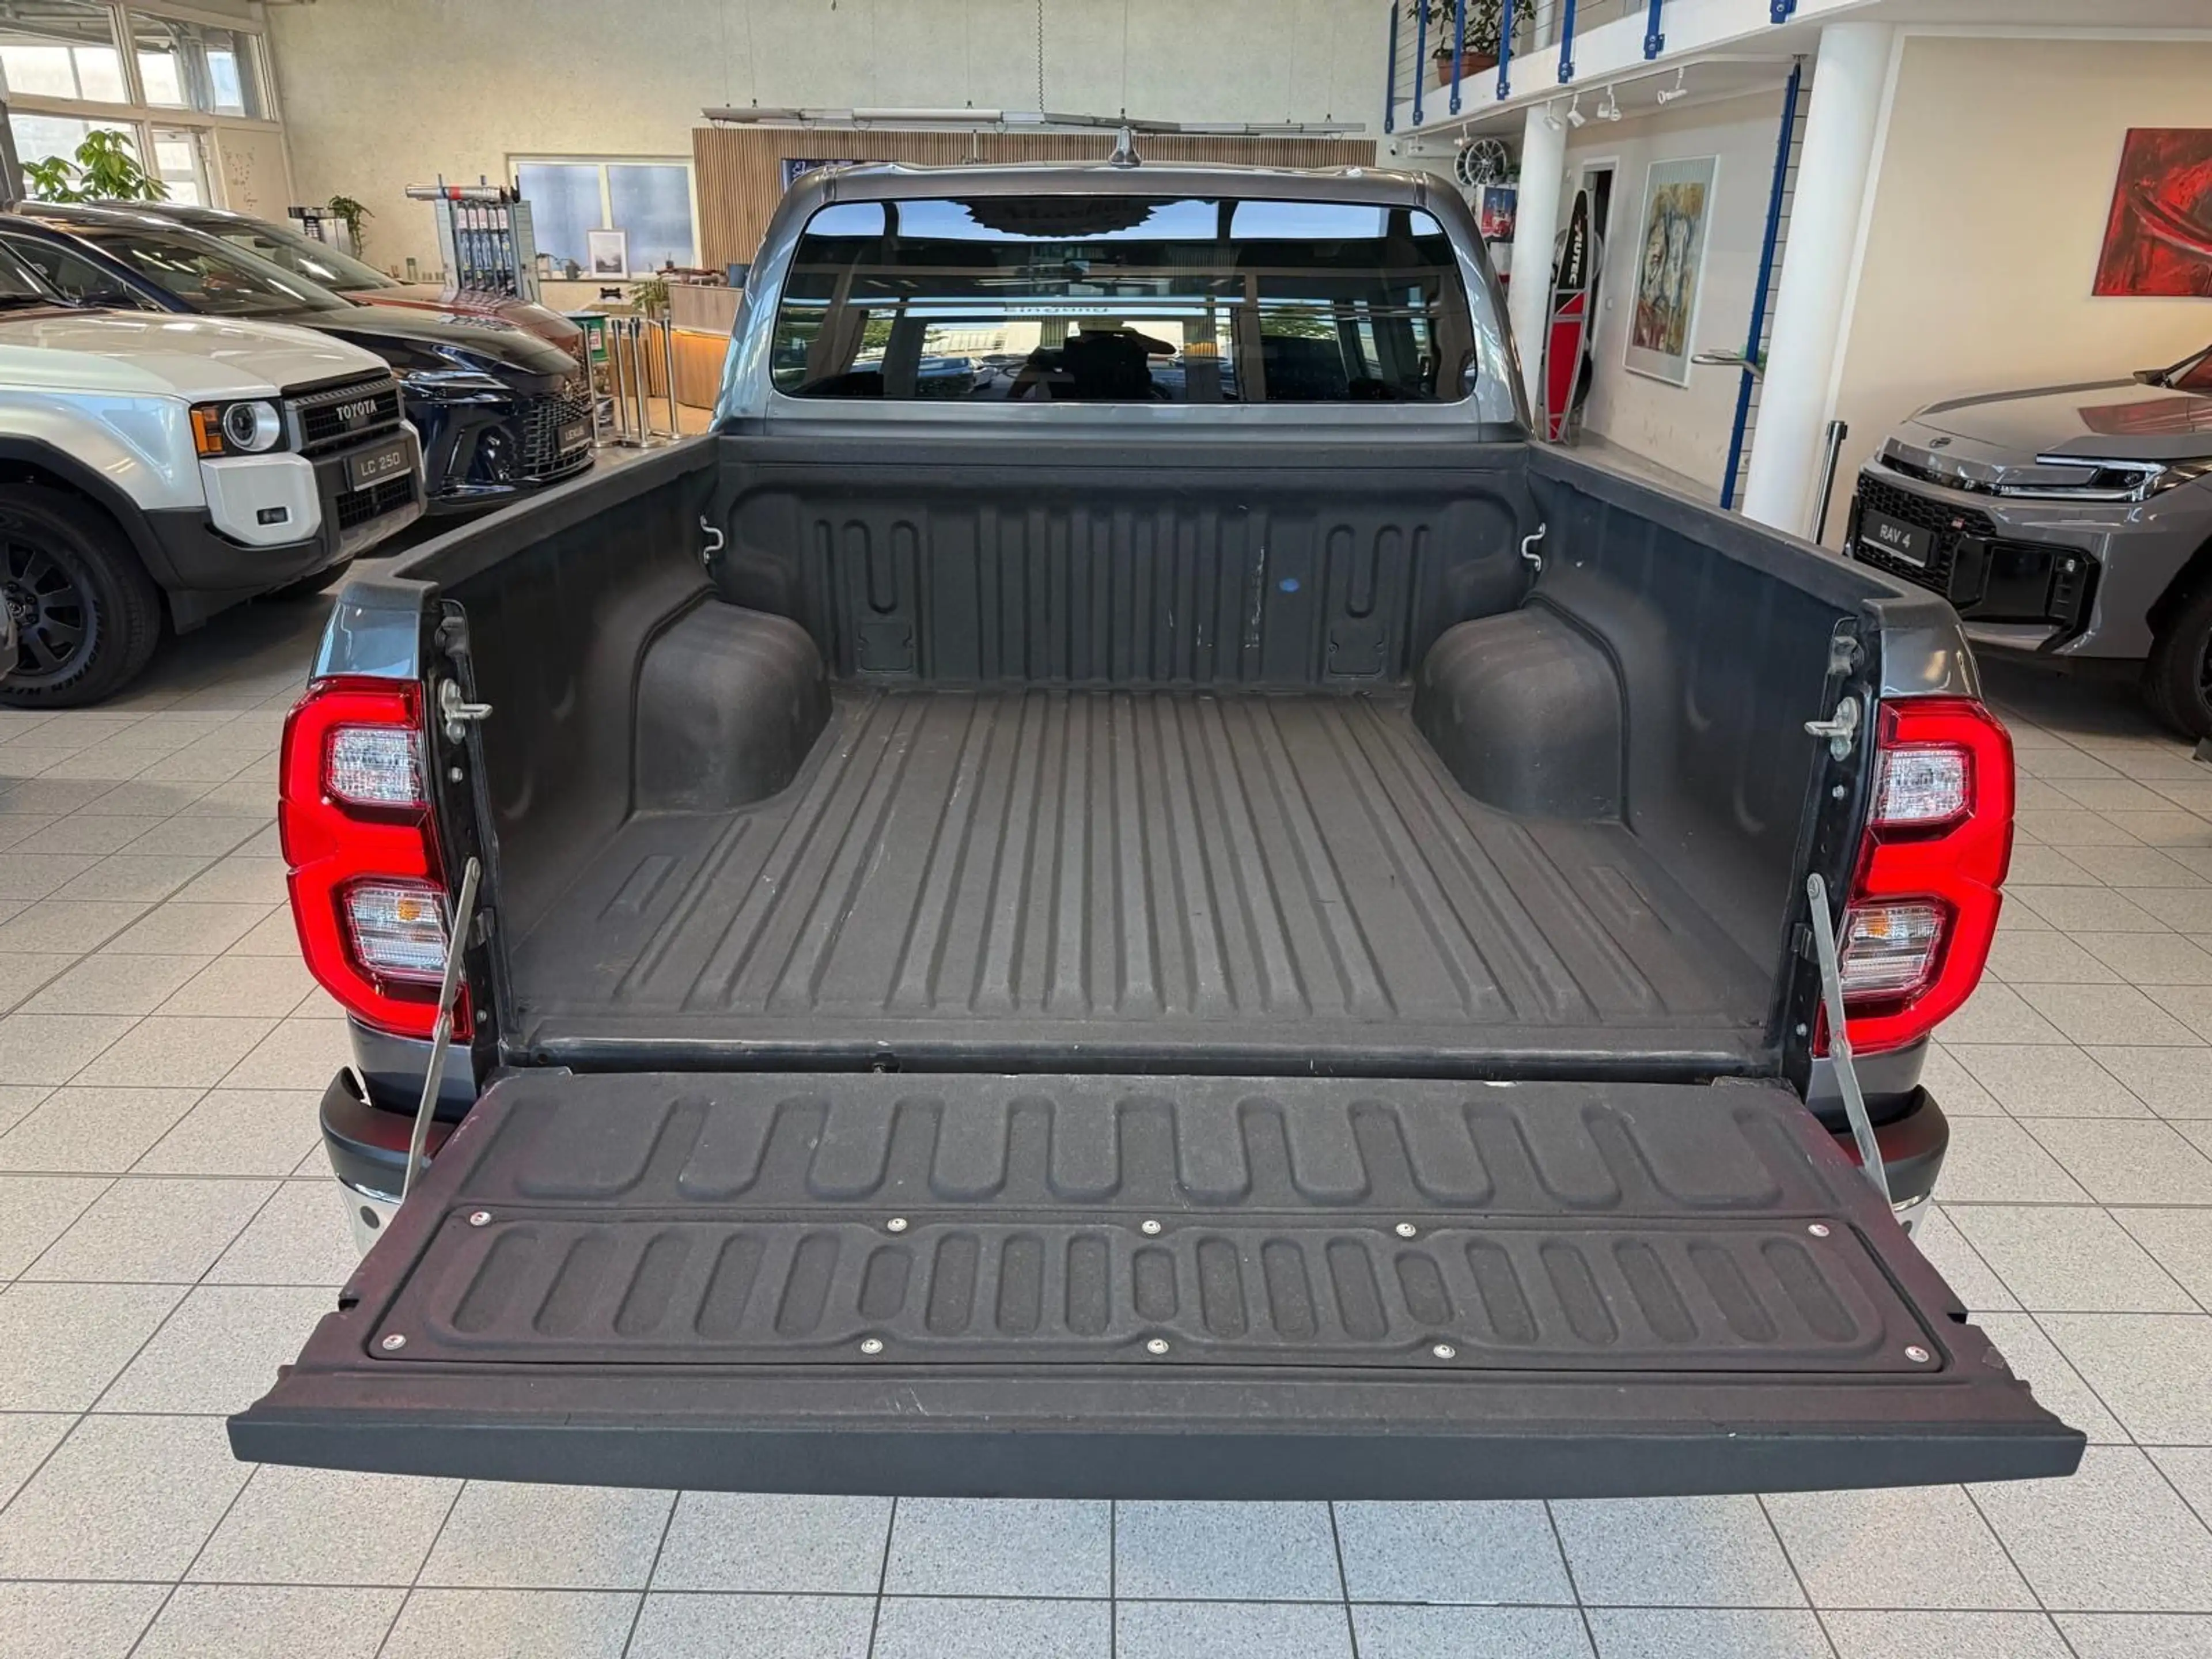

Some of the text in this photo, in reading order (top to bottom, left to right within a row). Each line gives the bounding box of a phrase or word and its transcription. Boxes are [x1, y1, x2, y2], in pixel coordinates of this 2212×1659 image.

[336, 399, 377, 421] TOYOTA
[361, 452, 400, 476] LC 250
[1880, 524, 1911, 548] RAV 4
